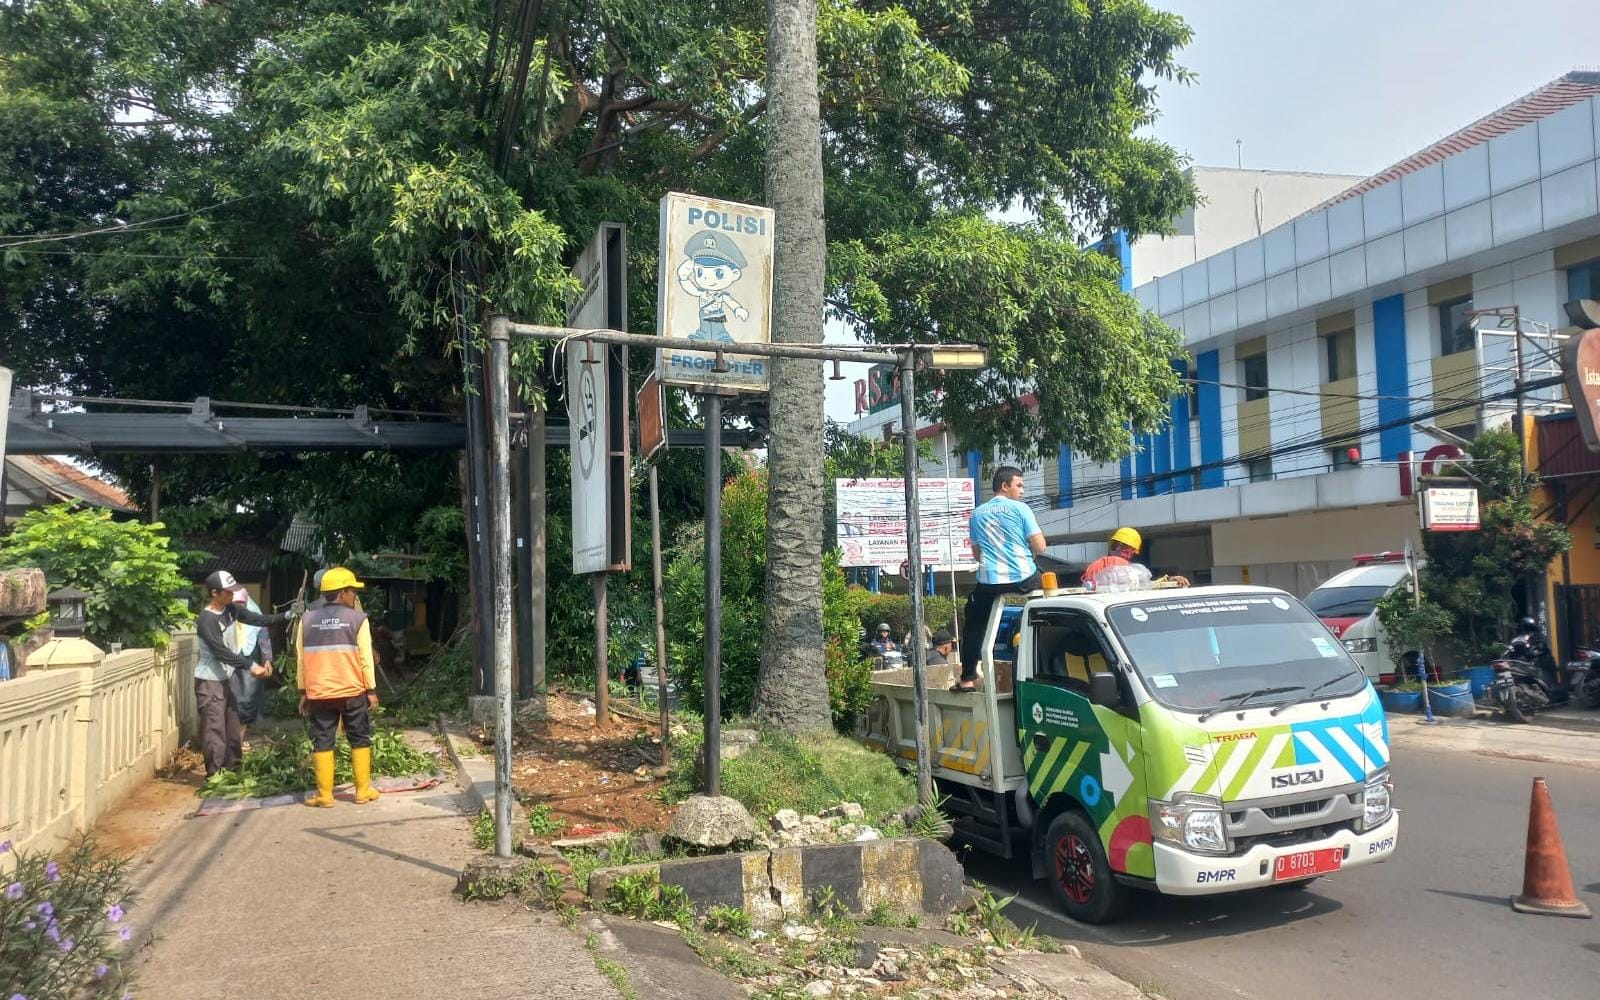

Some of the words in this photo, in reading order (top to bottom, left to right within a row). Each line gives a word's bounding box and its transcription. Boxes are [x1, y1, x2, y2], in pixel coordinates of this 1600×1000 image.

[688, 207, 766, 236] POLISI
[1214, 731, 1258, 743] TRAGA
[1271, 769, 1324, 789] ISUZU
[1368, 836, 1394, 855] BMPR
[1290, 852, 1315, 869] 8703
[1333, 849, 1341, 863] C
[1197, 868, 1236, 883] BMPR
